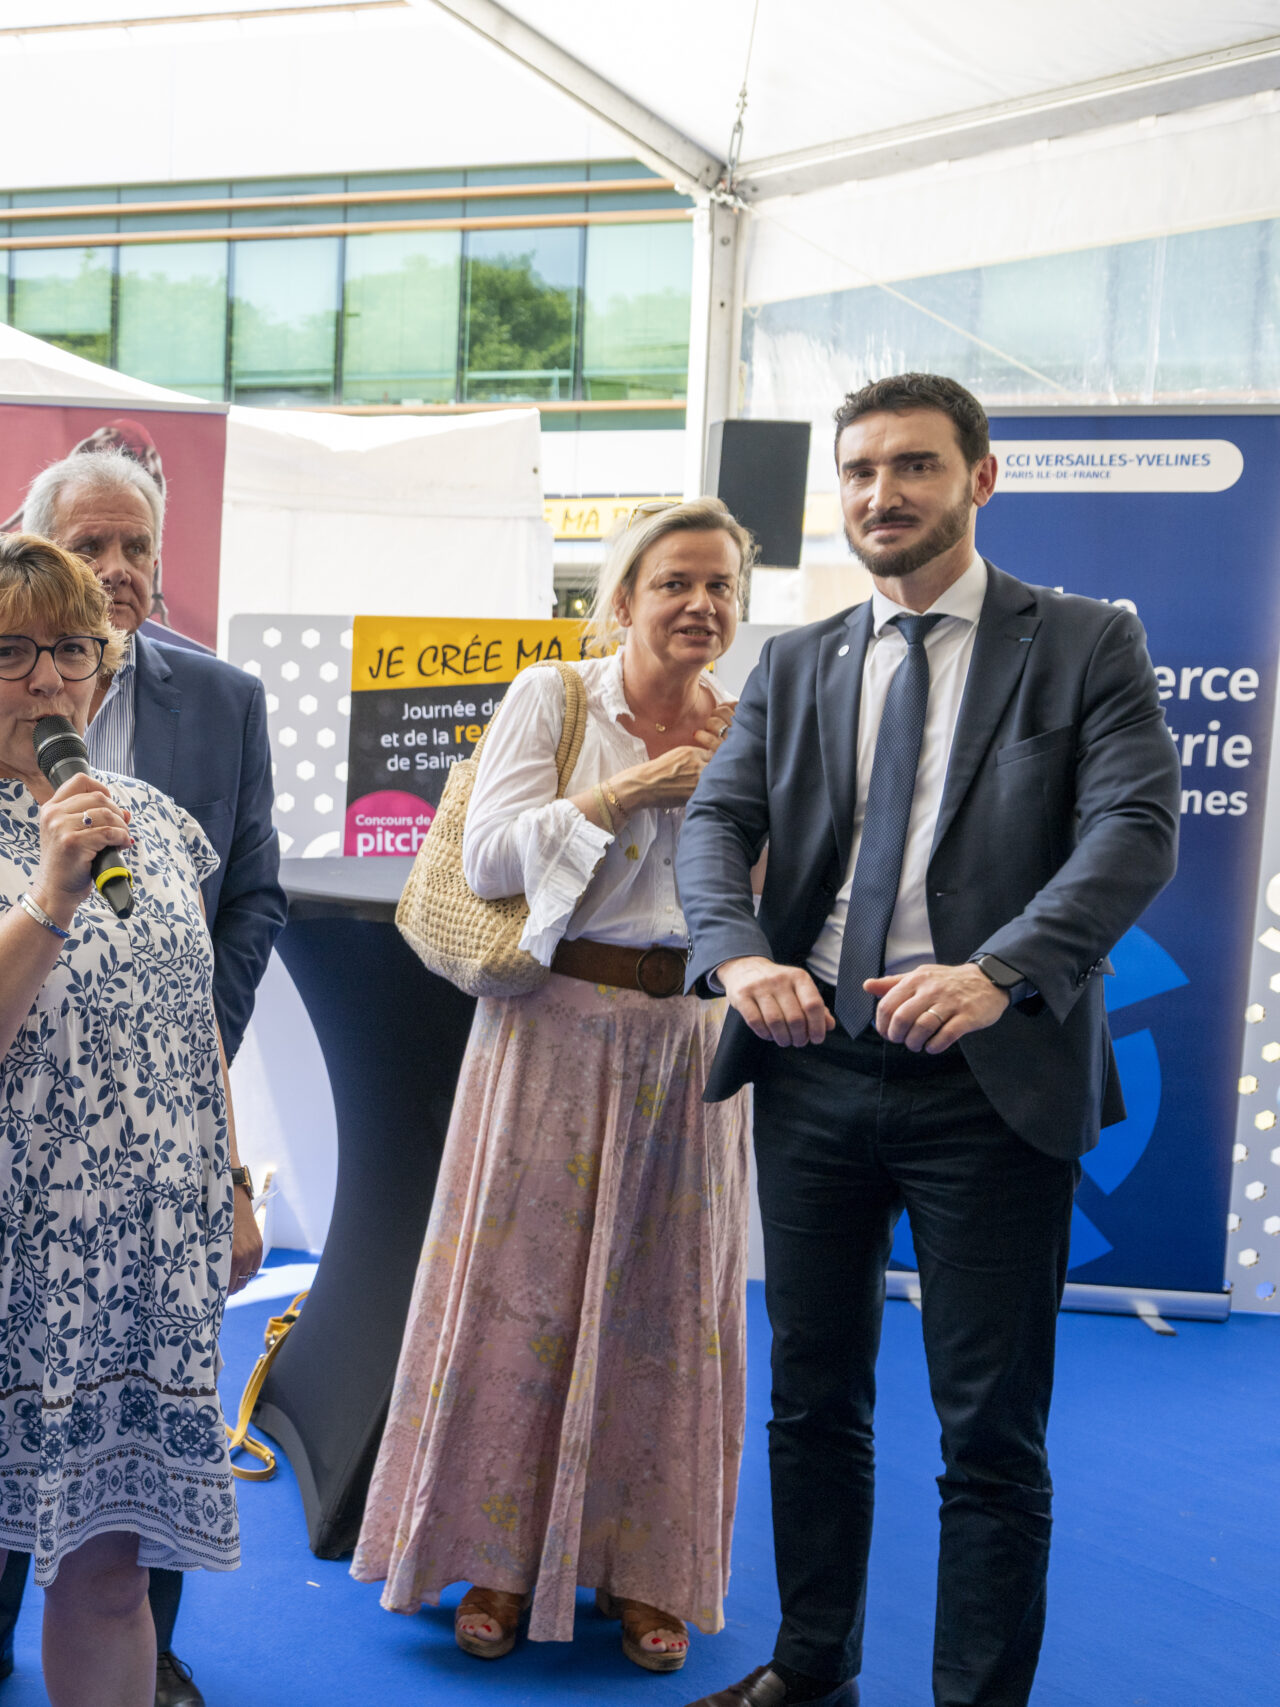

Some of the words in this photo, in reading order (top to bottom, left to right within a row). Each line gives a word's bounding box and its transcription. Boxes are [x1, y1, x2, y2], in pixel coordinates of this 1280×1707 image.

[1006, 453, 1030, 467] CCI
[1034, 453, 1211, 467] VERSAILLES-YVELINES
[1005, 470, 1034, 480] PARIS
[369, 646, 405, 679] JE
[417, 635, 502, 677] CRÉE
[516, 636, 563, 670] MA
[1153, 666, 1259, 702] erce
[402, 699, 477, 721] Journée
[380, 731, 399, 749] et
[404, 729, 428, 747] de
[433, 727, 449, 745] la
[387, 754, 410, 771] de
[355, 813, 413, 826] Concours
[415, 813, 431, 826] de
[357, 826, 427, 858] pitch
